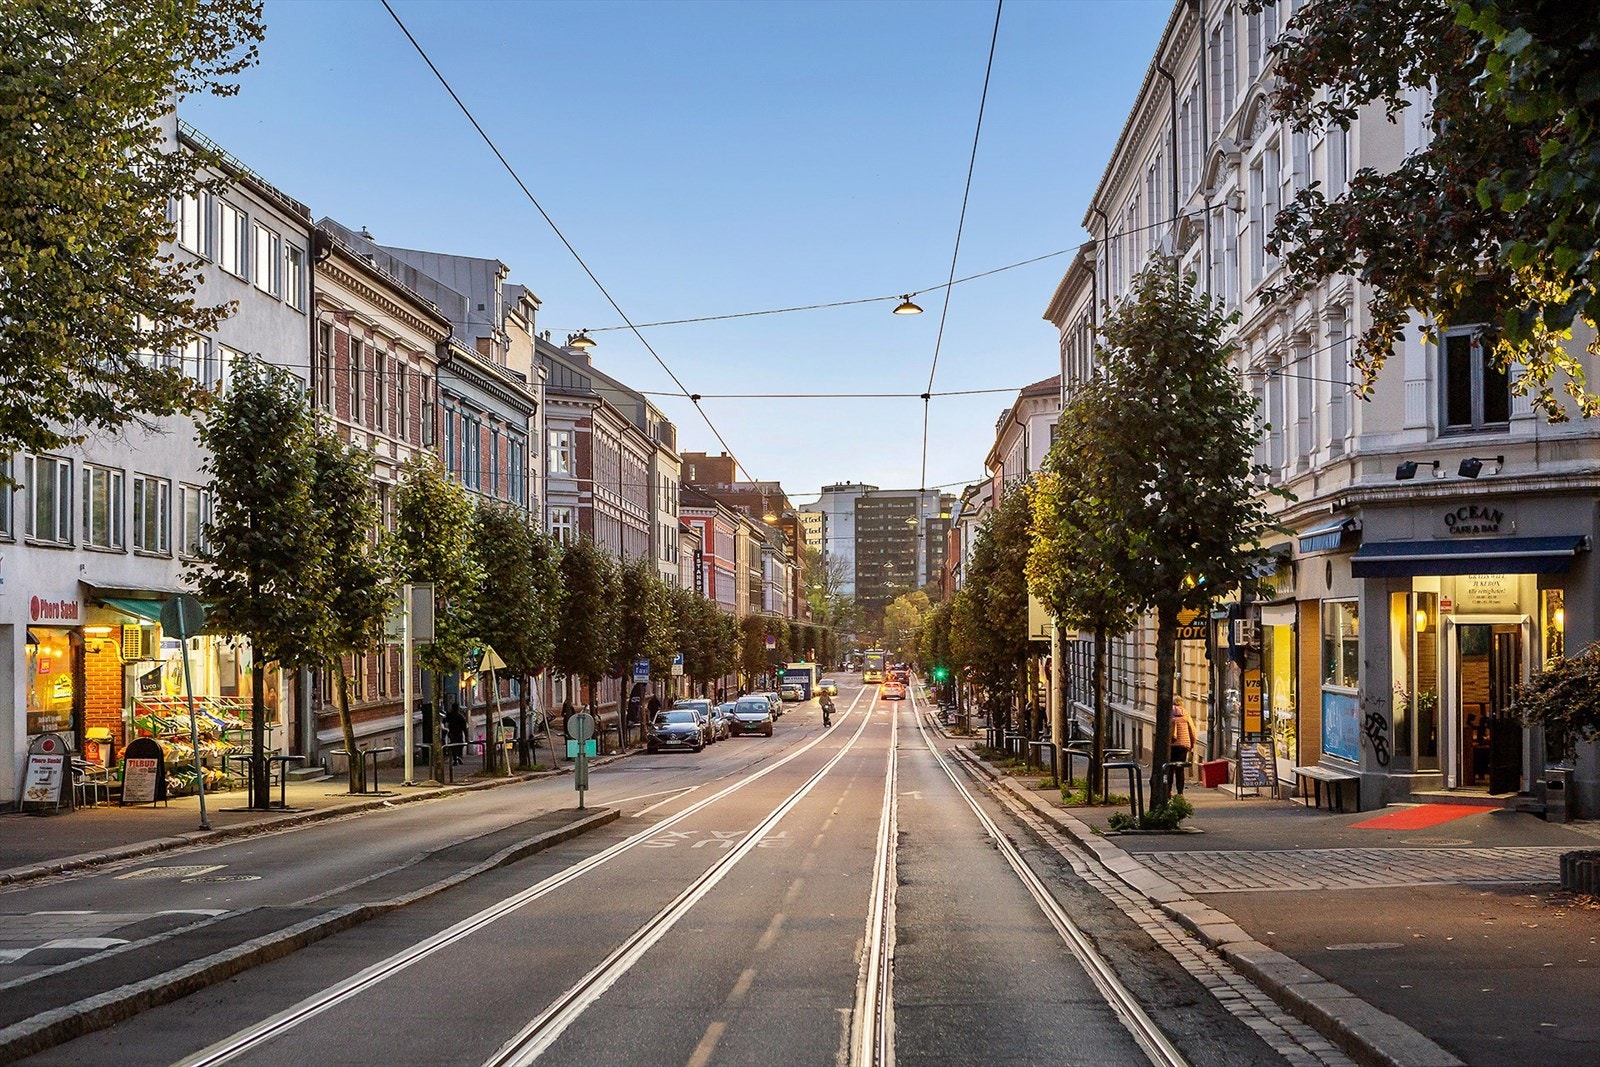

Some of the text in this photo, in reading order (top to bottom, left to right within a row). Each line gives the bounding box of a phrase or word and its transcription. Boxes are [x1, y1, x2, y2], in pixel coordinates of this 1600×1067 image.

[1444, 505, 1504, 526] OCEAN
[1473, 525, 1479, 533] &
[40, 599, 78, 619] Phoro Sushi
